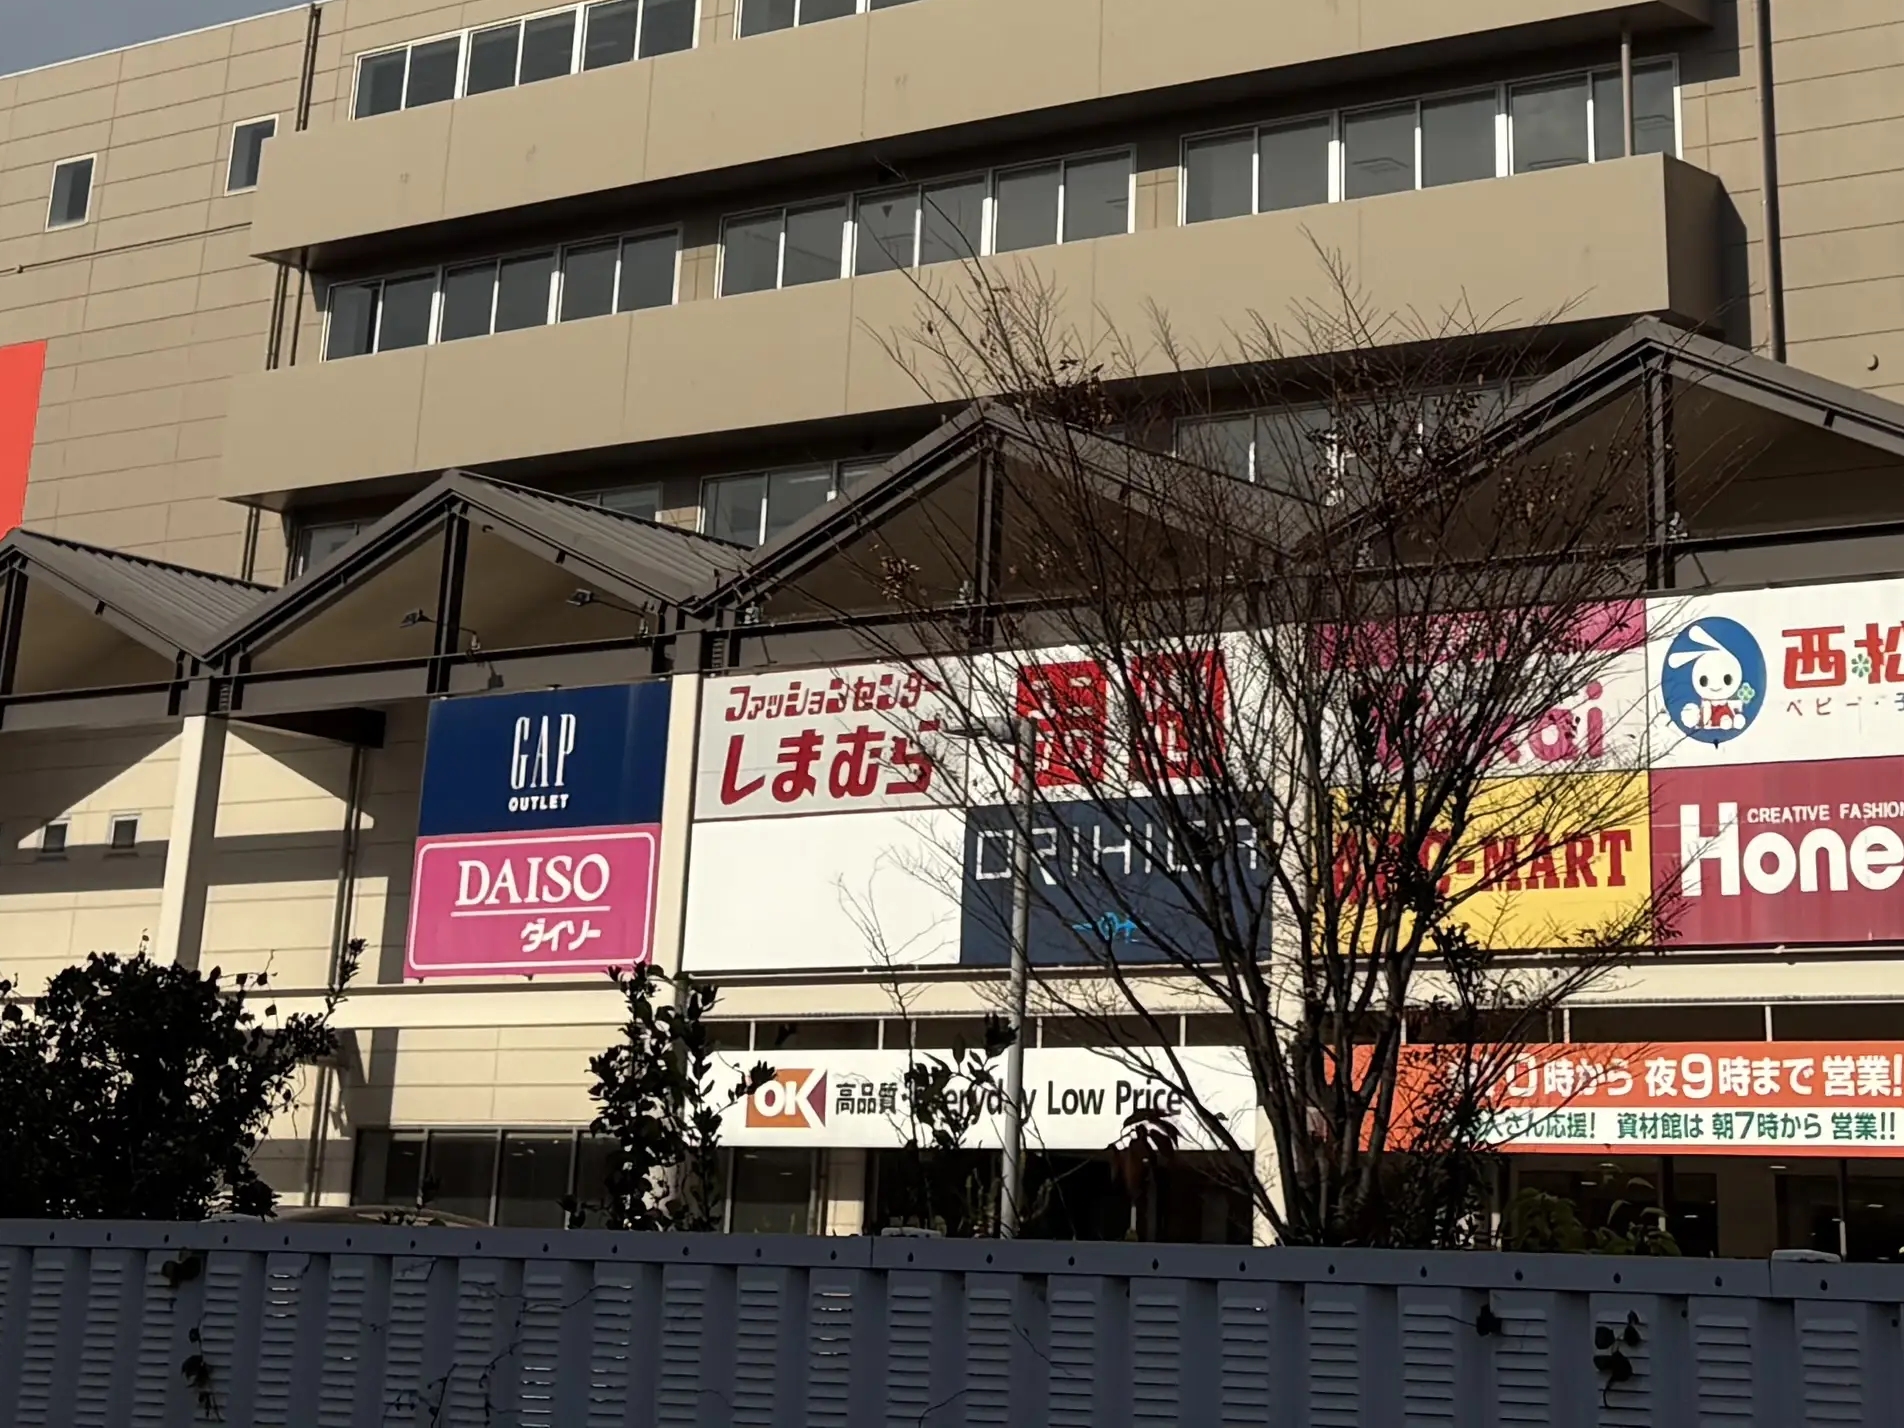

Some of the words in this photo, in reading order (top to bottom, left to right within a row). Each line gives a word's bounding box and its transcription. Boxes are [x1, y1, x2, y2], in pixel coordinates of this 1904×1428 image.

[725, 672, 943, 722] ファッションセンター
[510, 713, 576, 790] GAP
[720, 720, 941, 805] しまむら
[508, 793, 569, 813] OUTLET
[1747, 804, 1830, 825] CREATIVE
[455, 853, 611, 907] DAISO
[520, 917, 602, 953] ダイソー
[752, 1068, 827, 1128] OK
[1047, 1080, 1105, 1116] Low
[1115, 1080, 1183, 1116] Price
